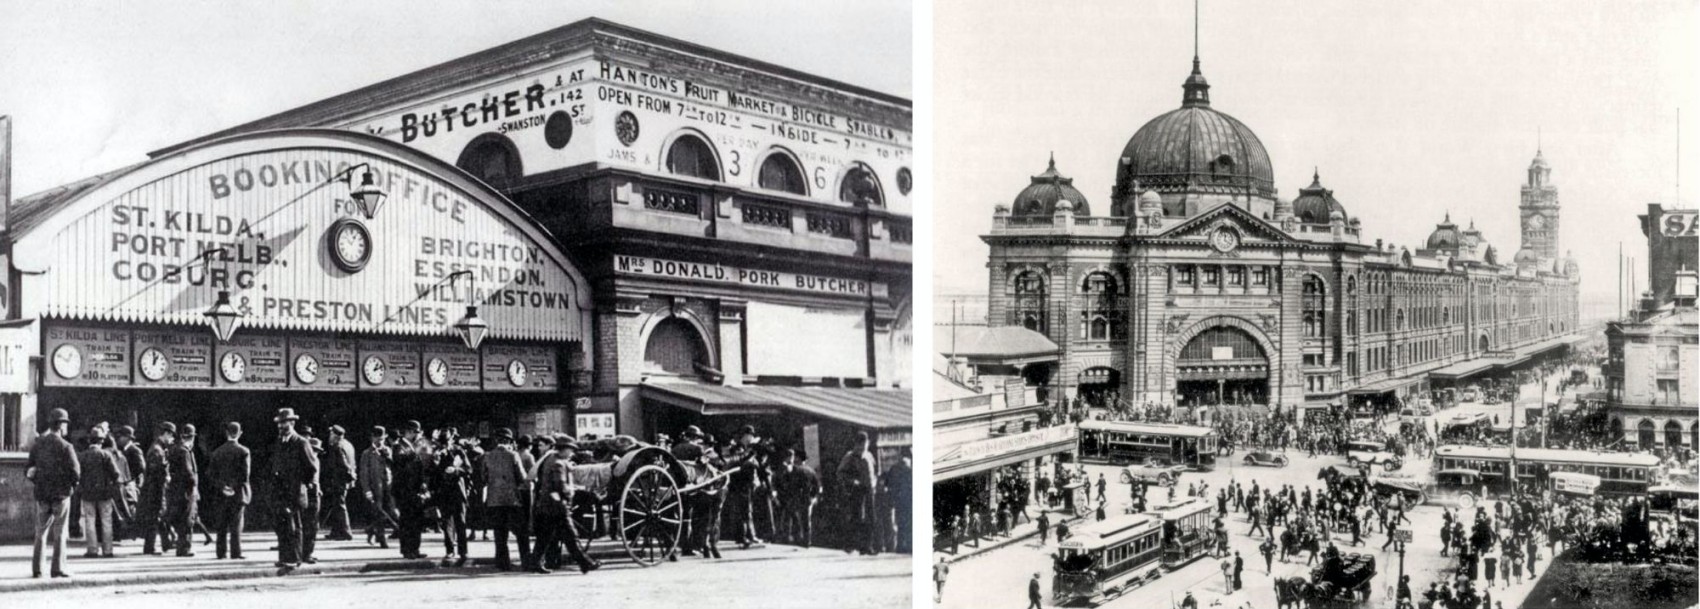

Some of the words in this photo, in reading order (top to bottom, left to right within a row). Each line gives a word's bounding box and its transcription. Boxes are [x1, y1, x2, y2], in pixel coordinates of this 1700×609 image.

[569, 69, 586, 83] AT
[560, 89, 584, 104] 142
[598, 86, 632, 107] OPEN
[638, 95, 672, 115] FROM
[600, 60, 679, 93] HANTON'S
[684, 81, 720, 102] FRUIT
[726, 90, 776, 116] MARKET
[792, 106, 836, 129] BICYCLE
[606, 149, 642, 169] JAMS
[729, 150, 742, 176] 3
[814, 166, 827, 190] 6
[112, 204, 156, 230] ST.
[333, 198, 360, 216] FO
[112, 232, 185, 258] PORT
[739, 270, 781, 286] PORK
[795, 275, 867, 295] BUTCHER
[414, 283, 569, 309] WILLIAMSTOWN
[262, 298, 373, 322] PRESTON
[384, 305, 448, 326] LINES
[66, 330, 98, 342] KILDA
[104, 332, 127, 343] LINE
[261, 339, 282, 348] LINE
[89, 370, 99, 380] 10
[173, 372, 179, 382] 9
[251, 374, 257, 383] 8
